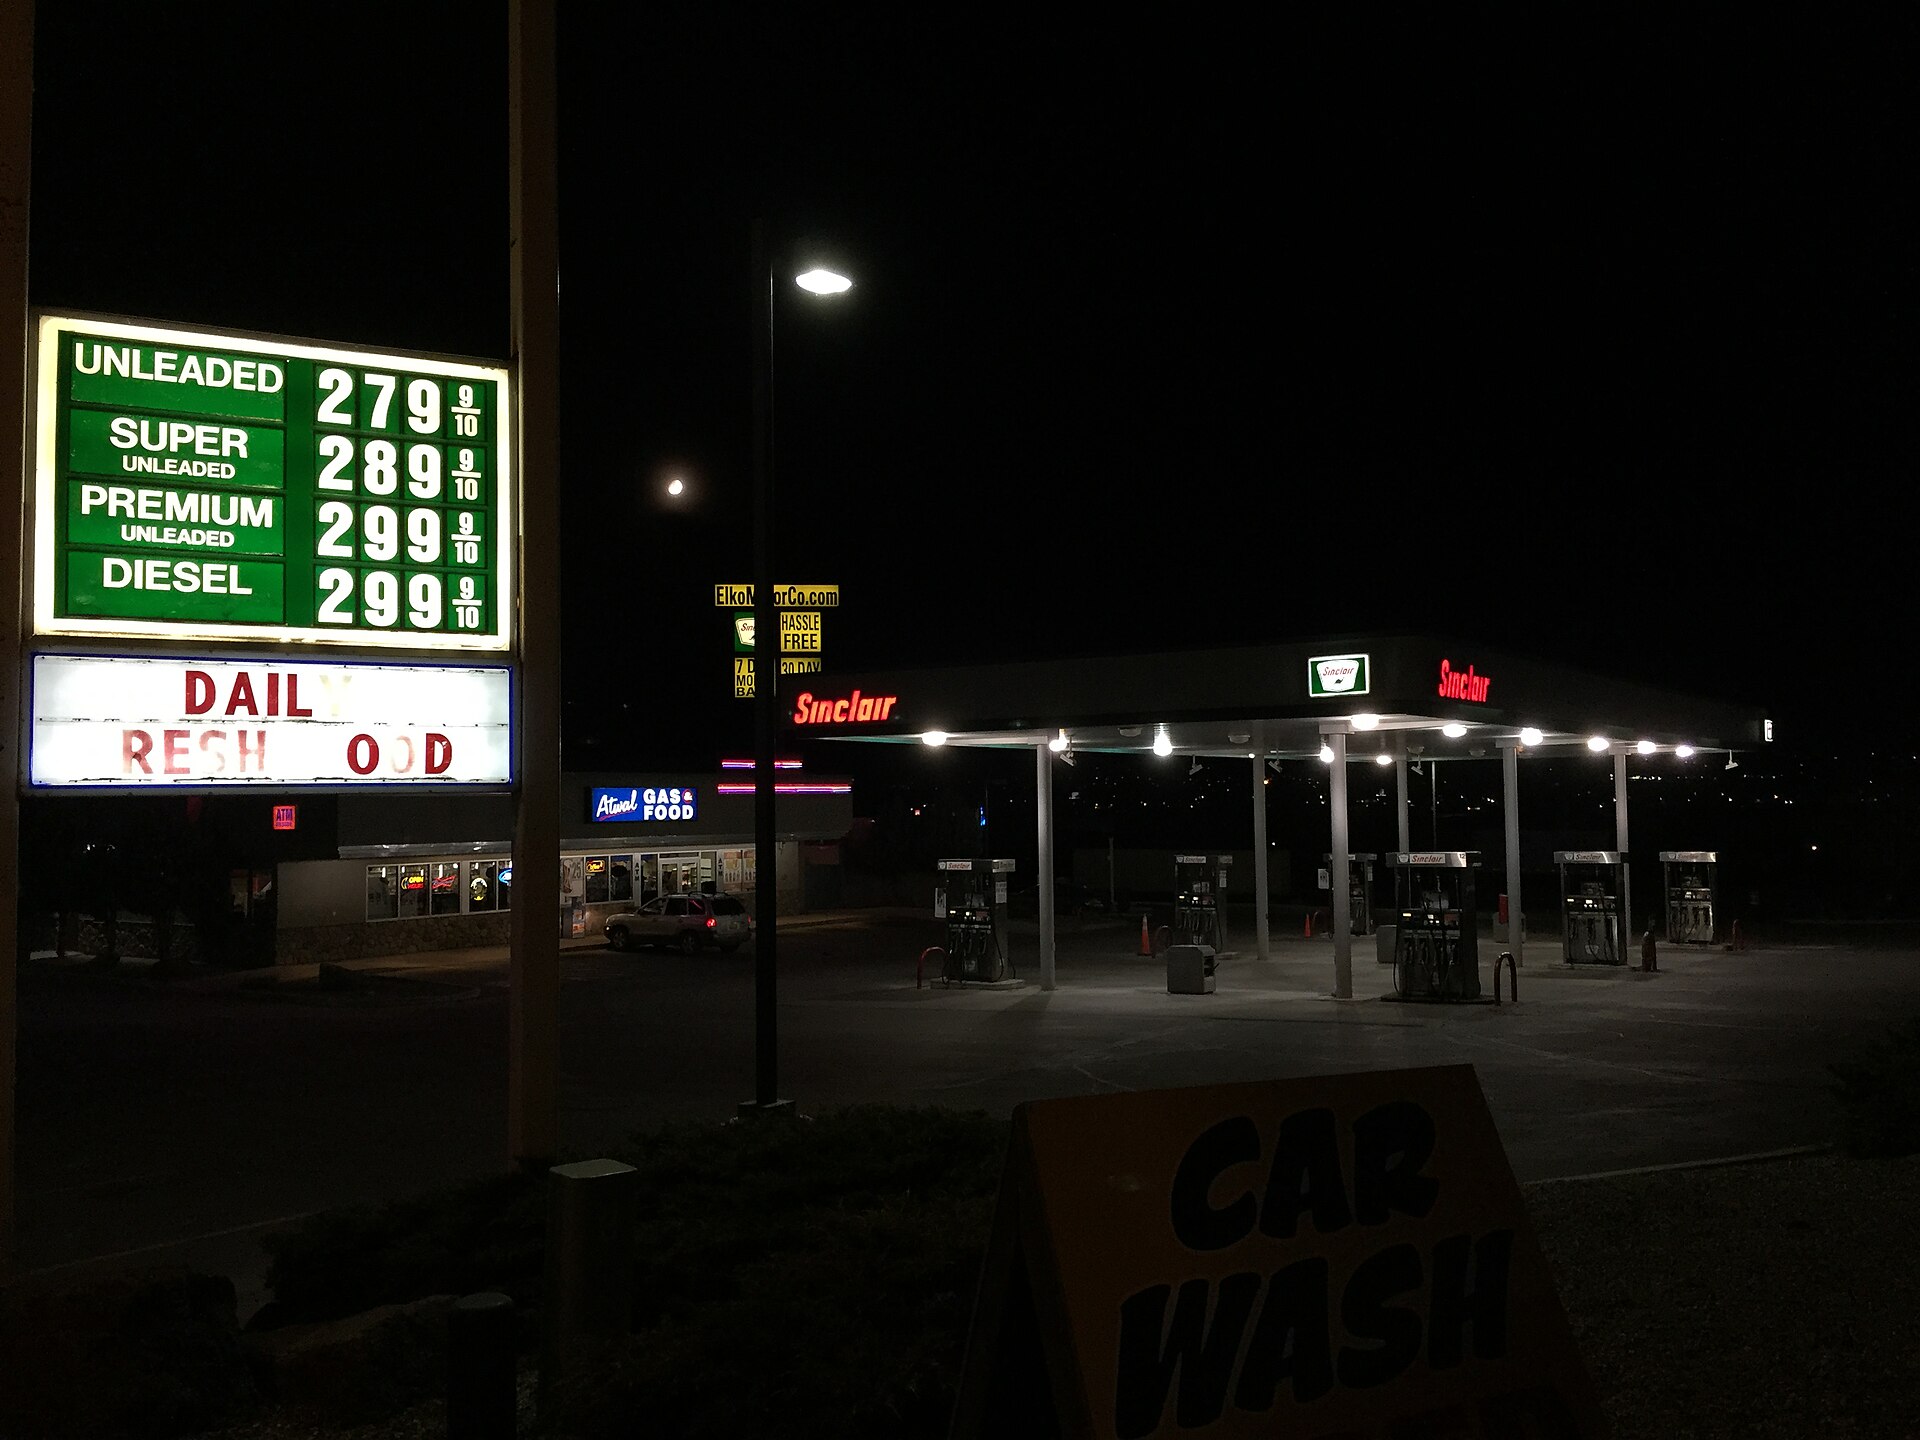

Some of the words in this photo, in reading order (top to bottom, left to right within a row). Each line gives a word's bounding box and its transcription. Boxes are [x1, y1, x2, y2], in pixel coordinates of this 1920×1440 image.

[75, 342, 283, 394] UNLEADED
[317, 368, 441, 434] 279
[109, 416, 248, 458] SUPER
[122, 455, 236, 480] UNLEADED
[318, 435, 441, 499] 289
[81, 484, 274, 528] PREMIUM
[120, 523, 235, 548] UNLEADED
[317, 501, 441, 563] 299
[102, 557, 252, 595] DIESEL
[317, 567, 442, 629] 299
[781, 614, 819, 631] HASSLE
[783, 633, 818, 650] FREE
[736, 659, 743, 673] 7
[1322, 666, 1354, 677] Sinclair
[1438, 659, 1490, 703] Sinclair
[794, 690, 897, 724] Sinclair
[122, 729, 266, 775] RESH
[596, 789, 638, 818] Atwal
[643, 788, 681, 805] GAS
[683, 791, 693, 801] &
[643, 804, 694, 820] FOOD
[276, 809, 293, 821] ATM
[1411, 855, 1443, 863] Sinclair
[1172, 1101, 1440, 1251] CAR
[1115, 1229, 1514, 1440] WASH
